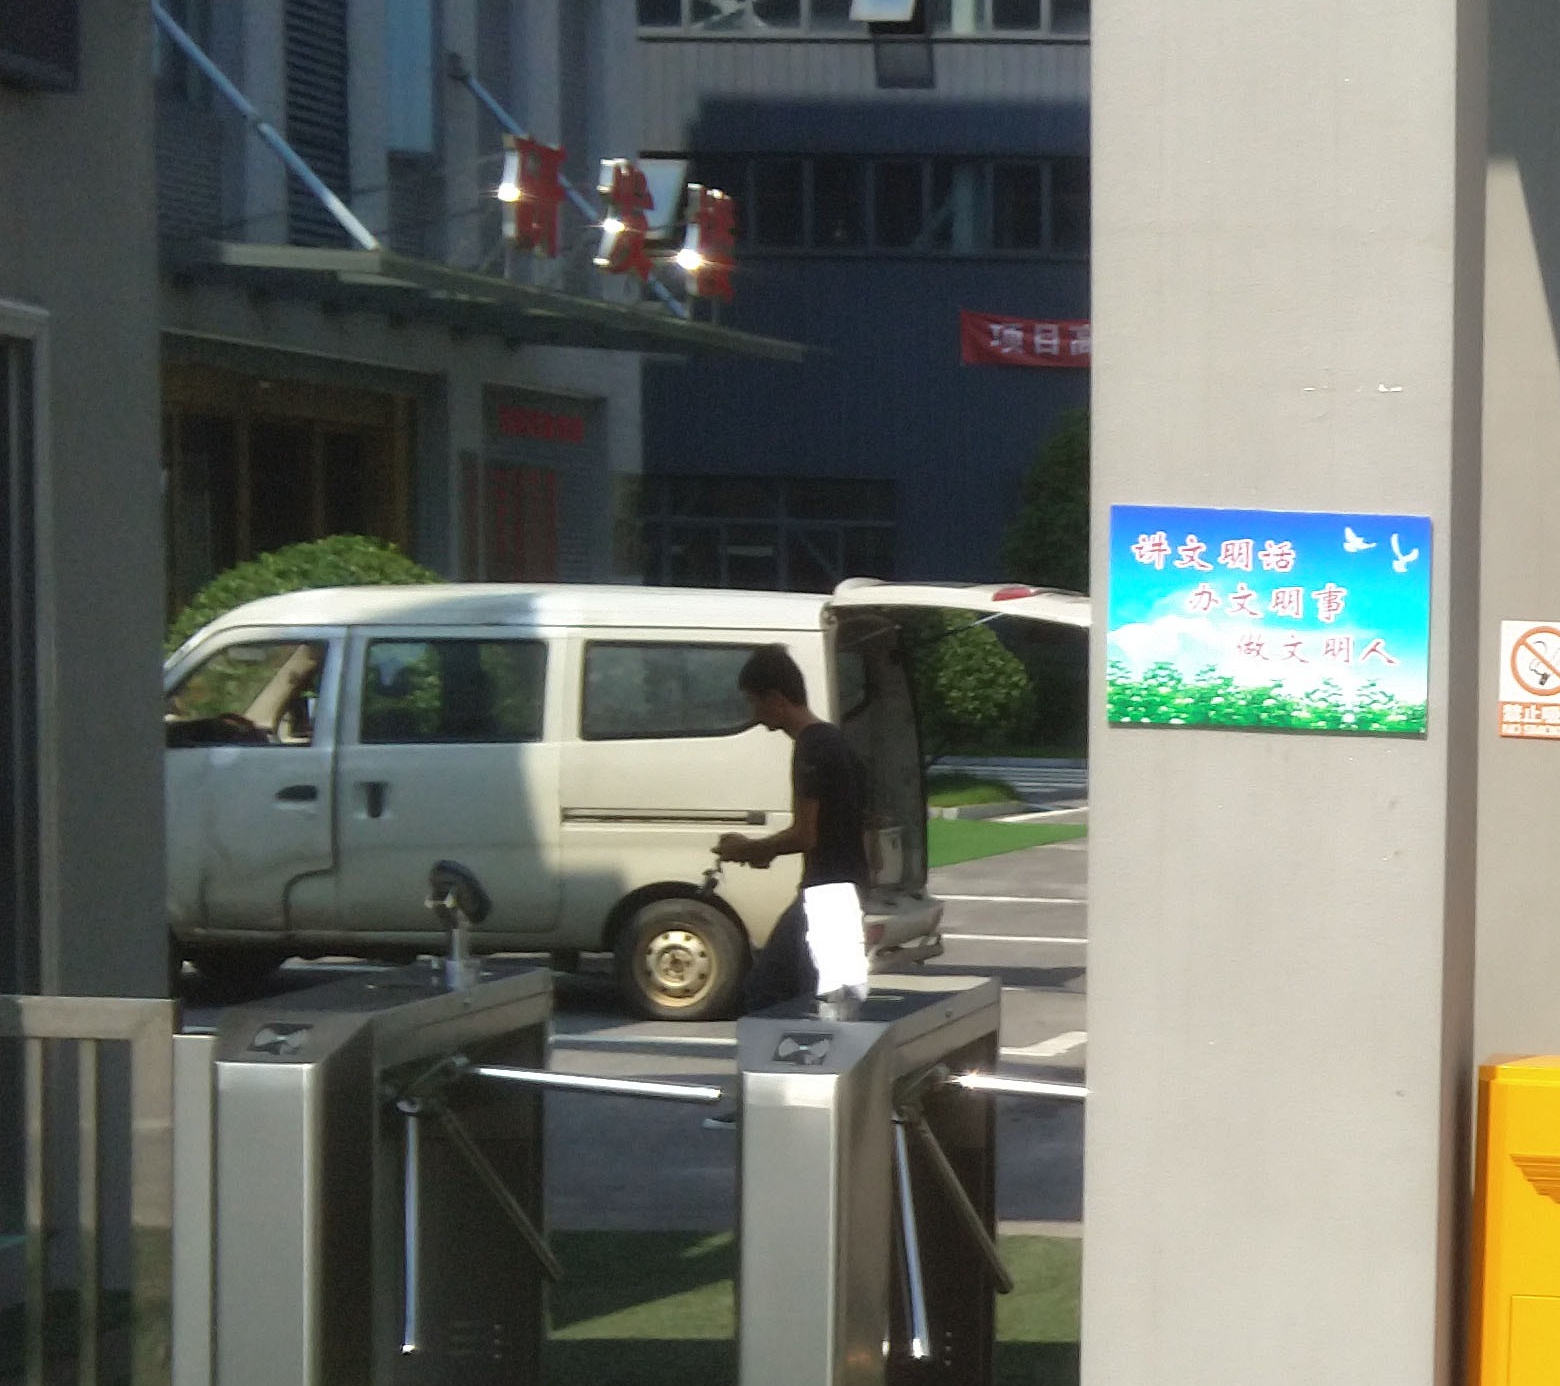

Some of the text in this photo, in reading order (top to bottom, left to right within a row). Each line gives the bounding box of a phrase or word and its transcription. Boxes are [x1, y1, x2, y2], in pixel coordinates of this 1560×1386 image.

[1131, 530, 1298, 572] 讲文明话
[1187, 581, 1350, 623] 办文明事
[1236, 632, 1400, 665] 做文明人
